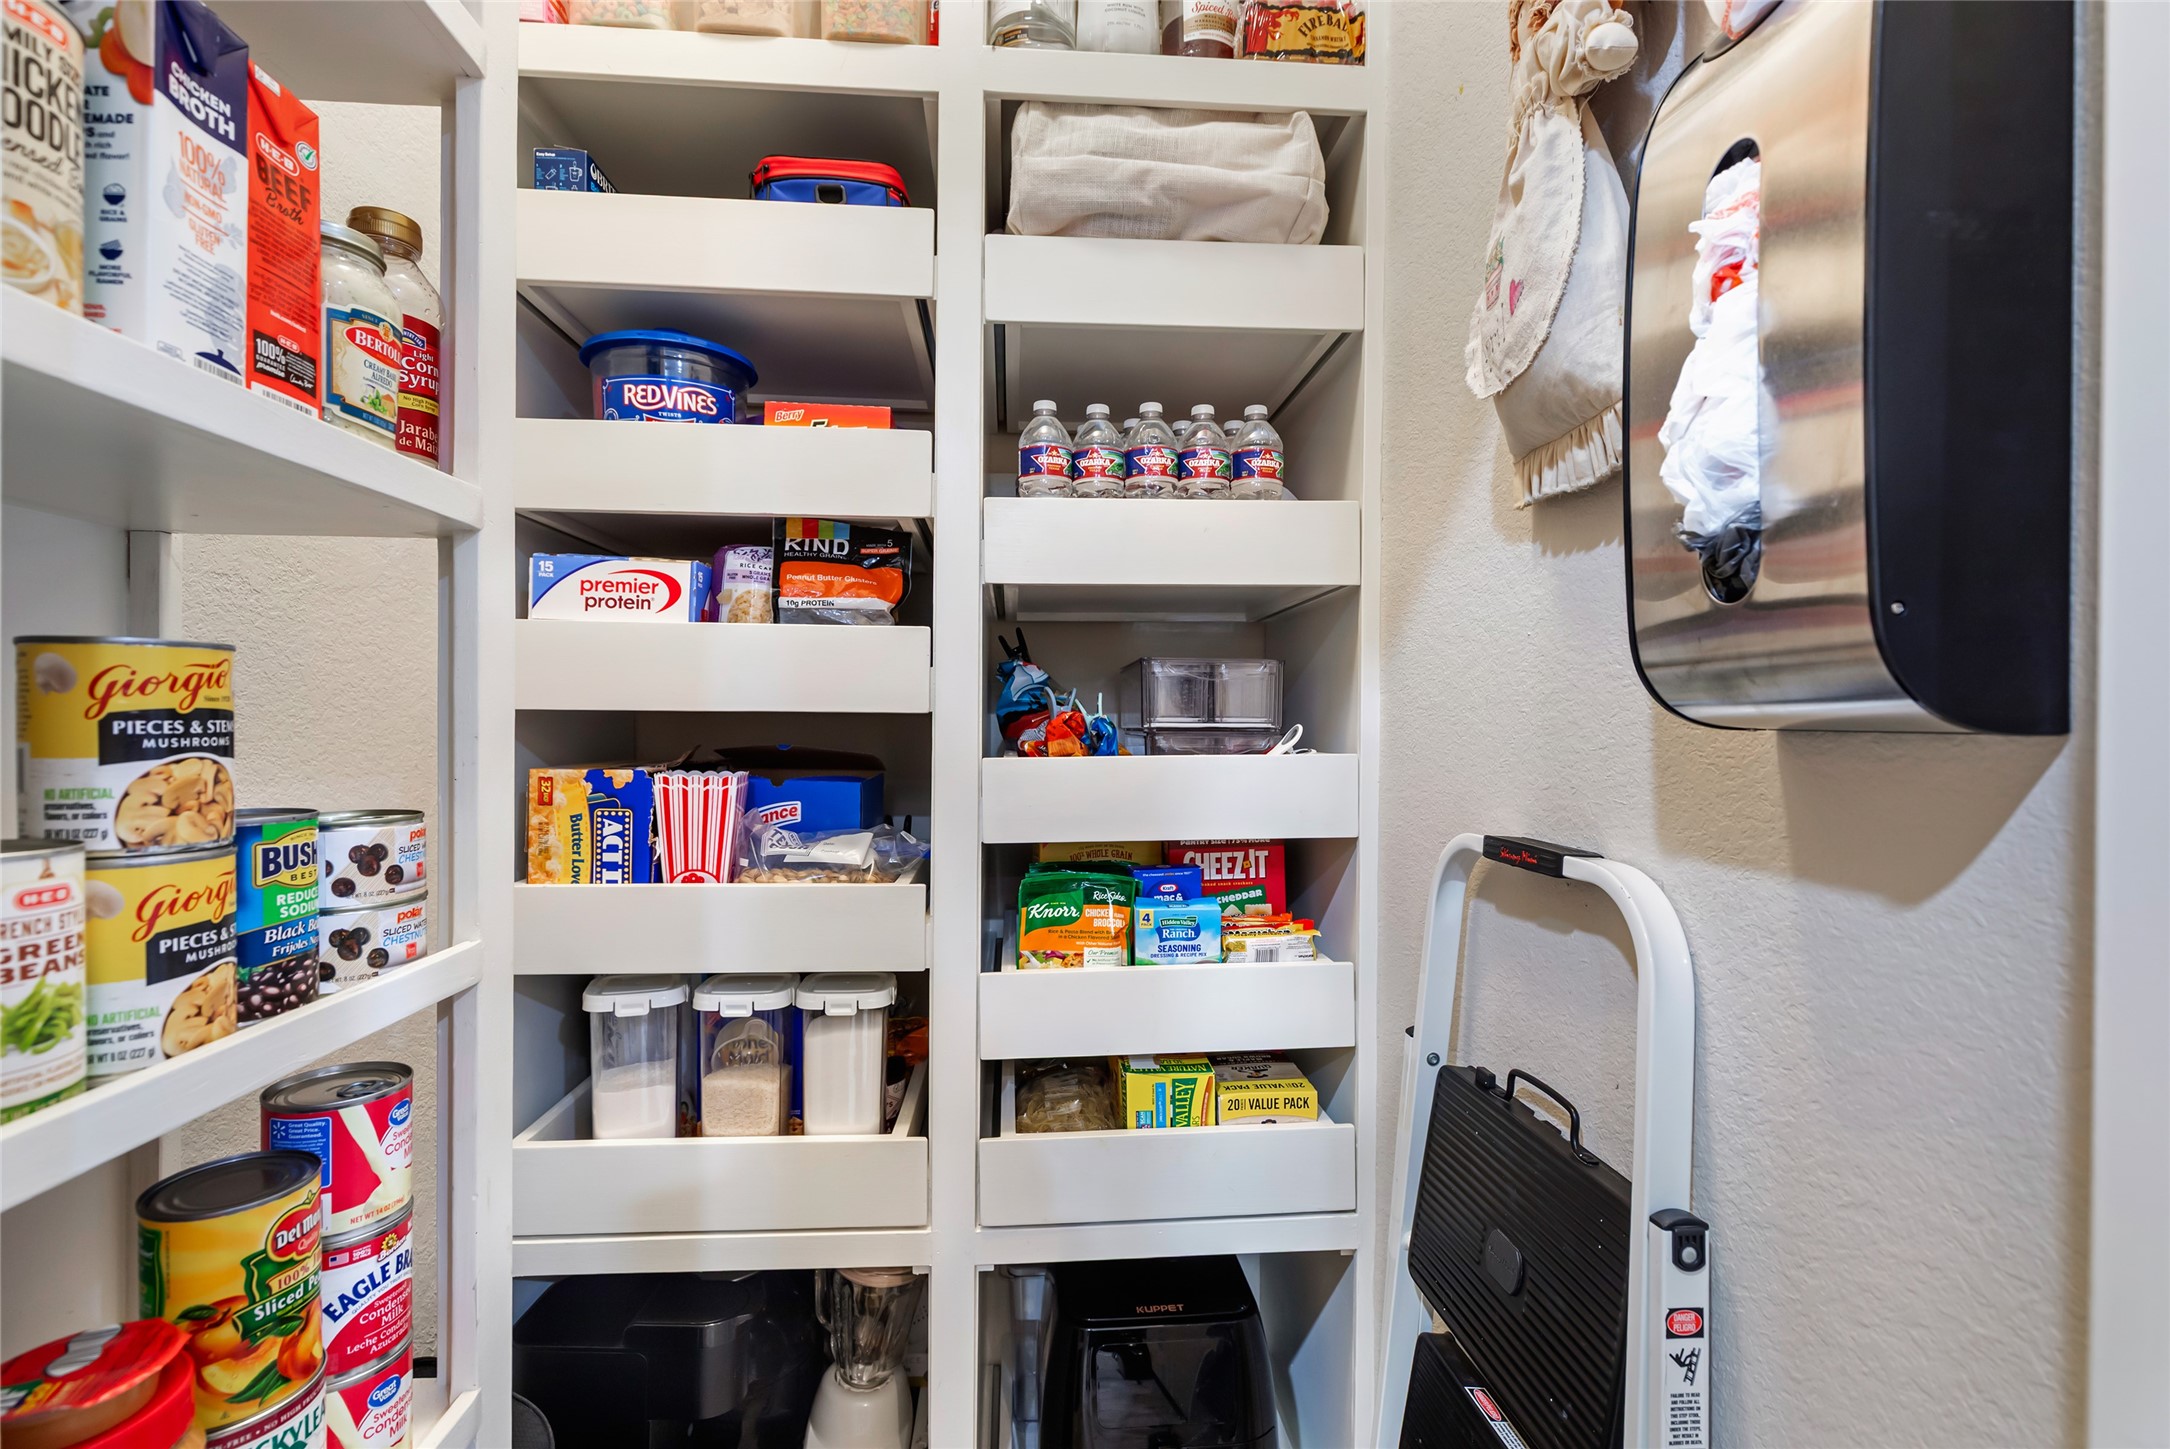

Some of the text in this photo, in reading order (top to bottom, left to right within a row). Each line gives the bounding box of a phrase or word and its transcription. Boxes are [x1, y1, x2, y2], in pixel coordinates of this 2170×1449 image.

[170, 61, 232, 118] CHICKEN
[168, 73, 236, 141] BROTH
[178, 130, 226, 186] 100%
[259, 137, 295, 171] H-E-B
[178, 156, 228, 204] NATURAL
[255, 152, 312, 213] BEEF
[264, 186, 304, 226] Broth
[255, 337, 287, 365] 100%
[413, 349, 435, 363] Light
[363, 359, 386, 375] CREAMY
[401, 356, 439, 378] Corn
[371, 371, 393, 389] ALFREDO
[399, 369, 440, 397] Syrup
[775, 410, 804, 422] Berry
[399, 435, 413, 447] de
[1037, 456, 1068, 466] OZARKA
[1079, 458, 1111, 467] OZARKA
[1140, 456, 1172, 465] OZARKA
[1188, 458, 1221, 467] OZARKA
[1251, 459, 1280, 468] OZARKA
[784, 538, 850, 557] KIND
[887, 539, 894, 548] 5
[783, 550, 818, 558] HEALTHY
[538, 560, 554, 572] 15
[580, 578, 660, 596] premier
[786, 573, 878, 586] Peanut Butter Clusters
[584, 595, 652, 612] protein
[800, 599, 835, 607] PROTEIN
[84, 658, 231, 721] Giorgio
[112, 719, 204, 736] PIECES &
[142, 736, 231, 749] MUSHROOMS
[58, 787, 115, 800] ARTIFICIAL
[541, 780, 552, 793] 32
[569, 812, 584, 857] Butter
[602, 818, 624, 865] ACT
[398, 843, 420, 856] SLICED
[1085, 848, 1109, 859] WHOLE
[1110, 849, 1133, 860] GRAIN
[1092, 890, 1107, 900] Rice
[1175, 892, 1184, 902] &
[396, 905, 424, 924] polar
[1027, 902, 1080, 919] Knorr
[1142, 913, 1151, 923] 4
[382, 924, 412, 938] SLICED
[1180, 919, 1196, 927] Valley
[159, 928, 229, 954] PIECES &
[264, 920, 306, 945] Black
[1162, 927, 1197, 939] Ranch
[271, 938, 309, 958] Frijoles
[1157, 943, 1202, 953] SEASONING
[101, 1006, 162, 1025] ARTIFICIAL
[1167, 1063, 1207, 1072] NATURE
[391, 1103, 410, 1120] Great
[1174, 1082, 1195, 1128] VALLEY
[1227, 1096, 1310, 1111] 20 VALUE PACK
[303, 1120, 328, 1129] Quality.
[303, 1126, 320, 1134] Price.
[287, 1132, 324, 1140] Guaranteed.
[350, 1203, 391, 1226] NET WT 14 OZ
[276, 1224, 302, 1250] Del
[276, 1263, 310, 1291] 100%
[322, 1260, 392, 1324] EAGLE
[253, 1286, 305, 1322] Sliced
[351, 1293, 377, 1315] QUALITY
[1136, 1303, 1184, 1314] KUPPET
[380, 1303, 404, 1327] Milk
[1673, 1313, 1696, 1322] DANGER
[1673, 1323, 1696, 1332] PELIGRO
[346, 1336, 378, 1355] Leche
[371, 1378, 398, 1400] Great
[263, 1406, 302, 1432] NO HIGH
[388, 1416, 408, 1438] Milk
